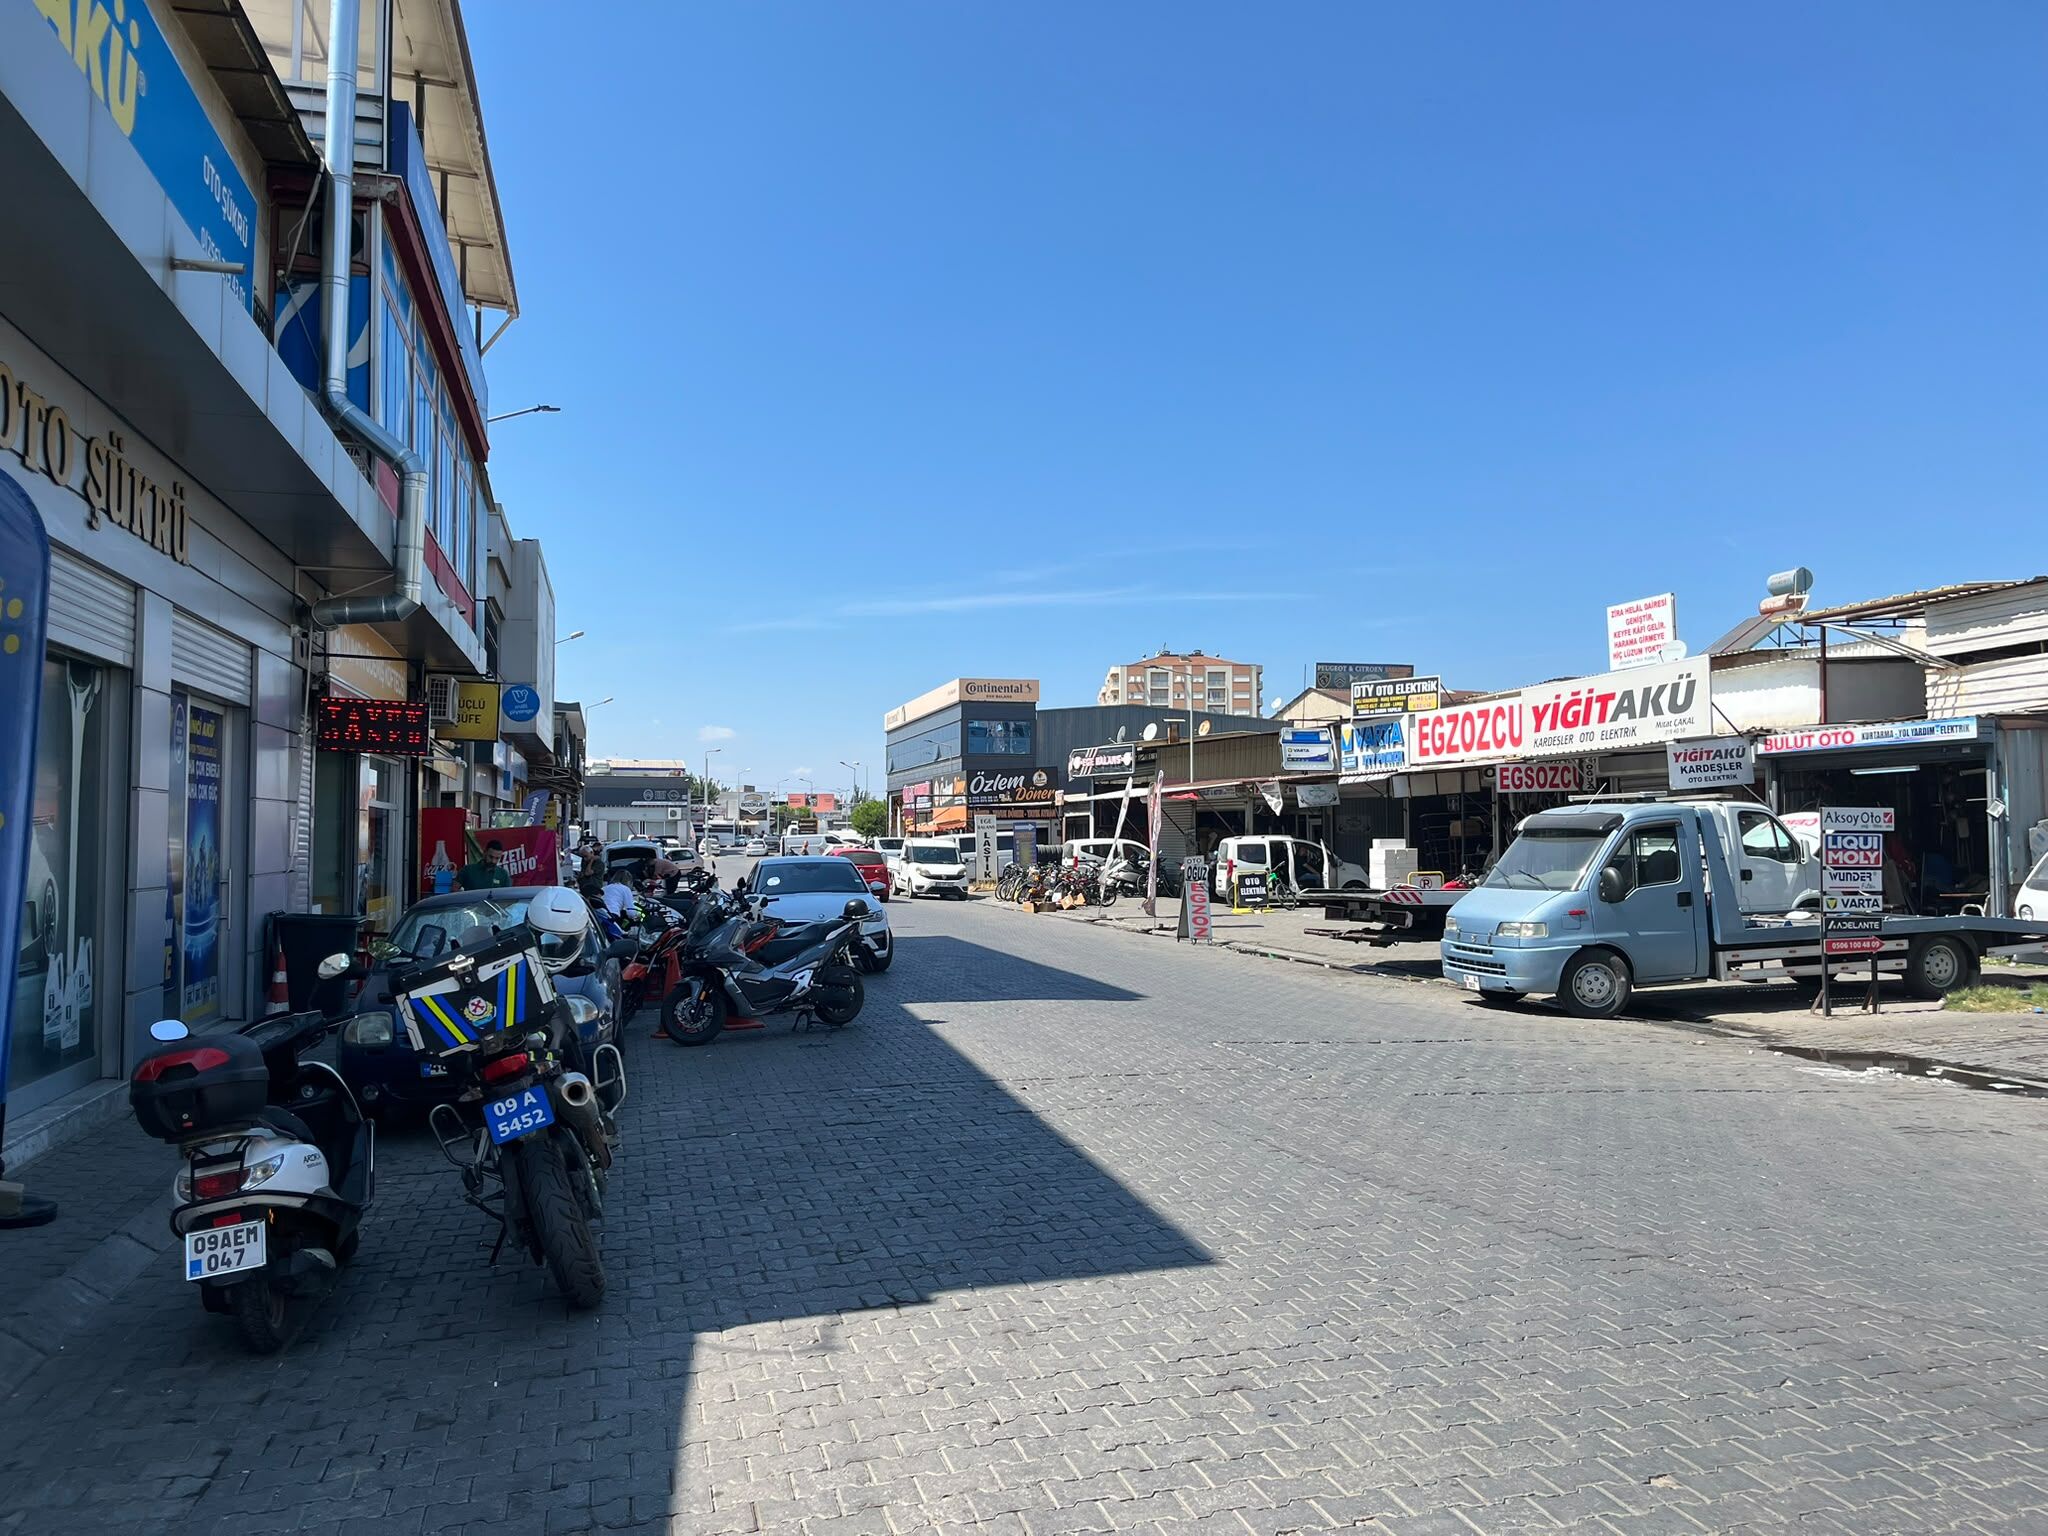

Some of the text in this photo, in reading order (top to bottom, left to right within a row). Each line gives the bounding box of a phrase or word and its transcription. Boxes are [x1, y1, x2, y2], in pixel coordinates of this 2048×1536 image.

[203, 155, 249, 248] OTO ŞÜKRÜ
[0, 361, 190, 567] OTO ŞÜKRÜ
[1644, 597, 1667, 610] DAİRESİ
[1613, 628, 1631, 638] KEYFE
[1614, 632, 1665, 649] HARAMA GİRMEYE
[1623, 647, 1643, 658] LÜZUM
[1318, 664, 1347, 673] PEUGEOT
[965, 681, 1023, 695] Continental
[1353, 685, 1374, 698] DTY
[1376, 684, 1394, 697] OTO
[458, 696, 486, 711] ÜÇLÜ
[1354, 721, 1405, 748] VARTA
[1418, 702, 1523, 757] EGZOZCU
[1579, 731, 1595, 743] OTO
[1861, 729, 1894, 740] KURTARMA
[1764, 730, 1855, 752] BULUT OTO
[1673, 745, 1746, 763] YİĞİTAKÜ
[1680, 762, 1742, 774] KARDEŞLER
[970, 771, 1025, 795] Özlem
[1499, 765, 1584, 790] EGSOZCU
[1015, 786, 1056, 801] Döner
[1828, 835, 1878, 849] LIQUI
[1828, 850, 1881, 865] MOLY
[1245, 877, 1260, 886] OTO
[1240, 886, 1267, 896] ELEKTRİK
[1840, 899, 1880, 909] VARTA
[1837, 921, 1880, 930] ADELANTE
[1831, 942, 1849, 950] 0506
[493, 1091, 538, 1117] 09 A
[497, 1108, 547, 1137] 5452
[194, 1226, 258, 1254] 09AEM
[207, 1248, 246, 1272] 047
